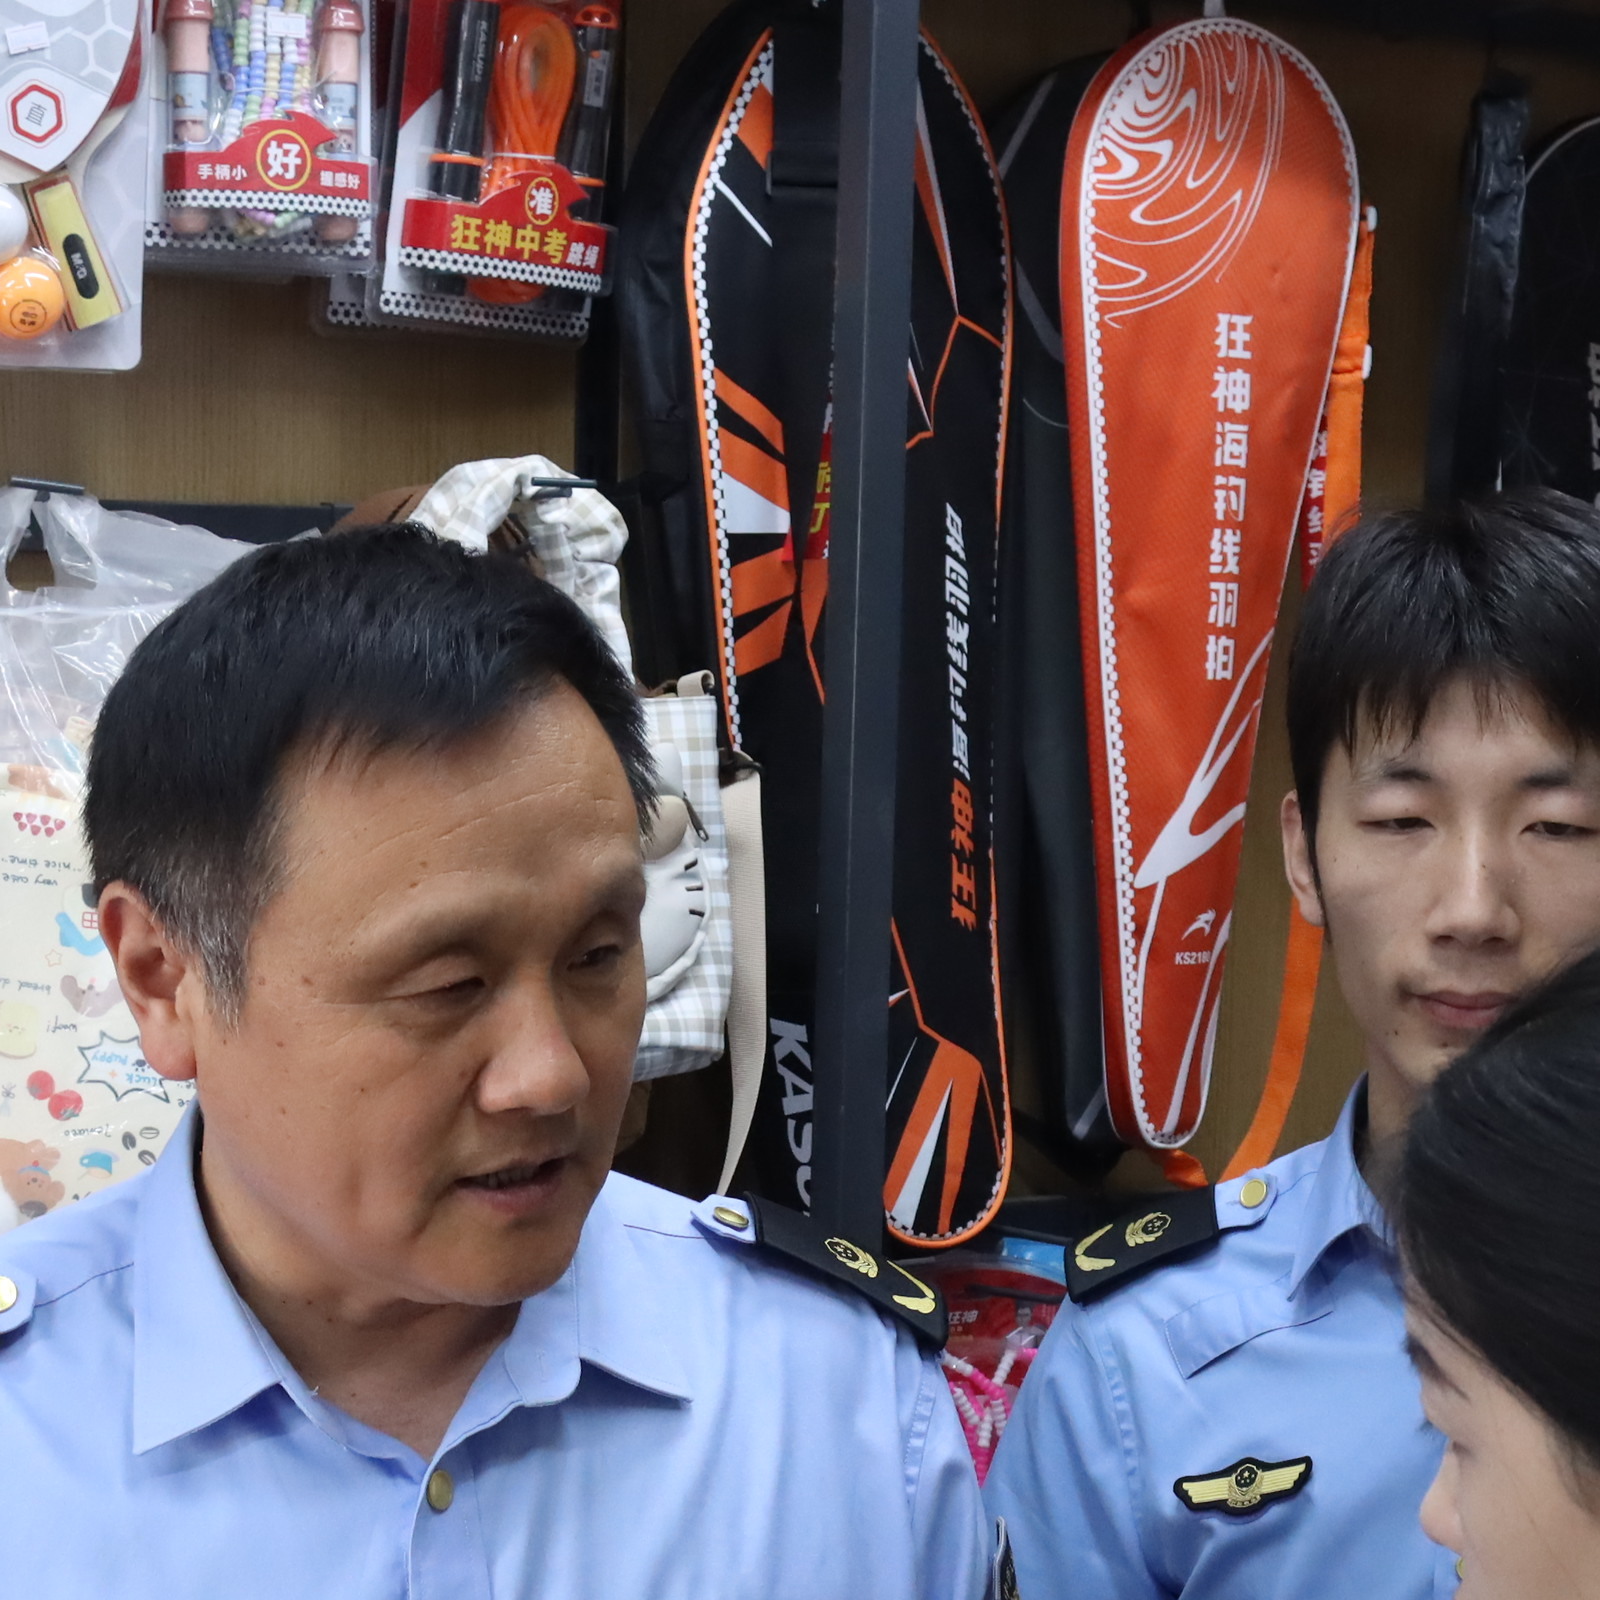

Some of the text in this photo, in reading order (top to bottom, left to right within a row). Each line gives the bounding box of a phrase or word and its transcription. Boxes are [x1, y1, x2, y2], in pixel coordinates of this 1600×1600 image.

[197, 163, 248, 182] 手柄小
[266, 140, 302, 180] 好
[528, 187, 555, 216] 准
[1204, 312, 1255, 682] 狂神海钓线羽拍
